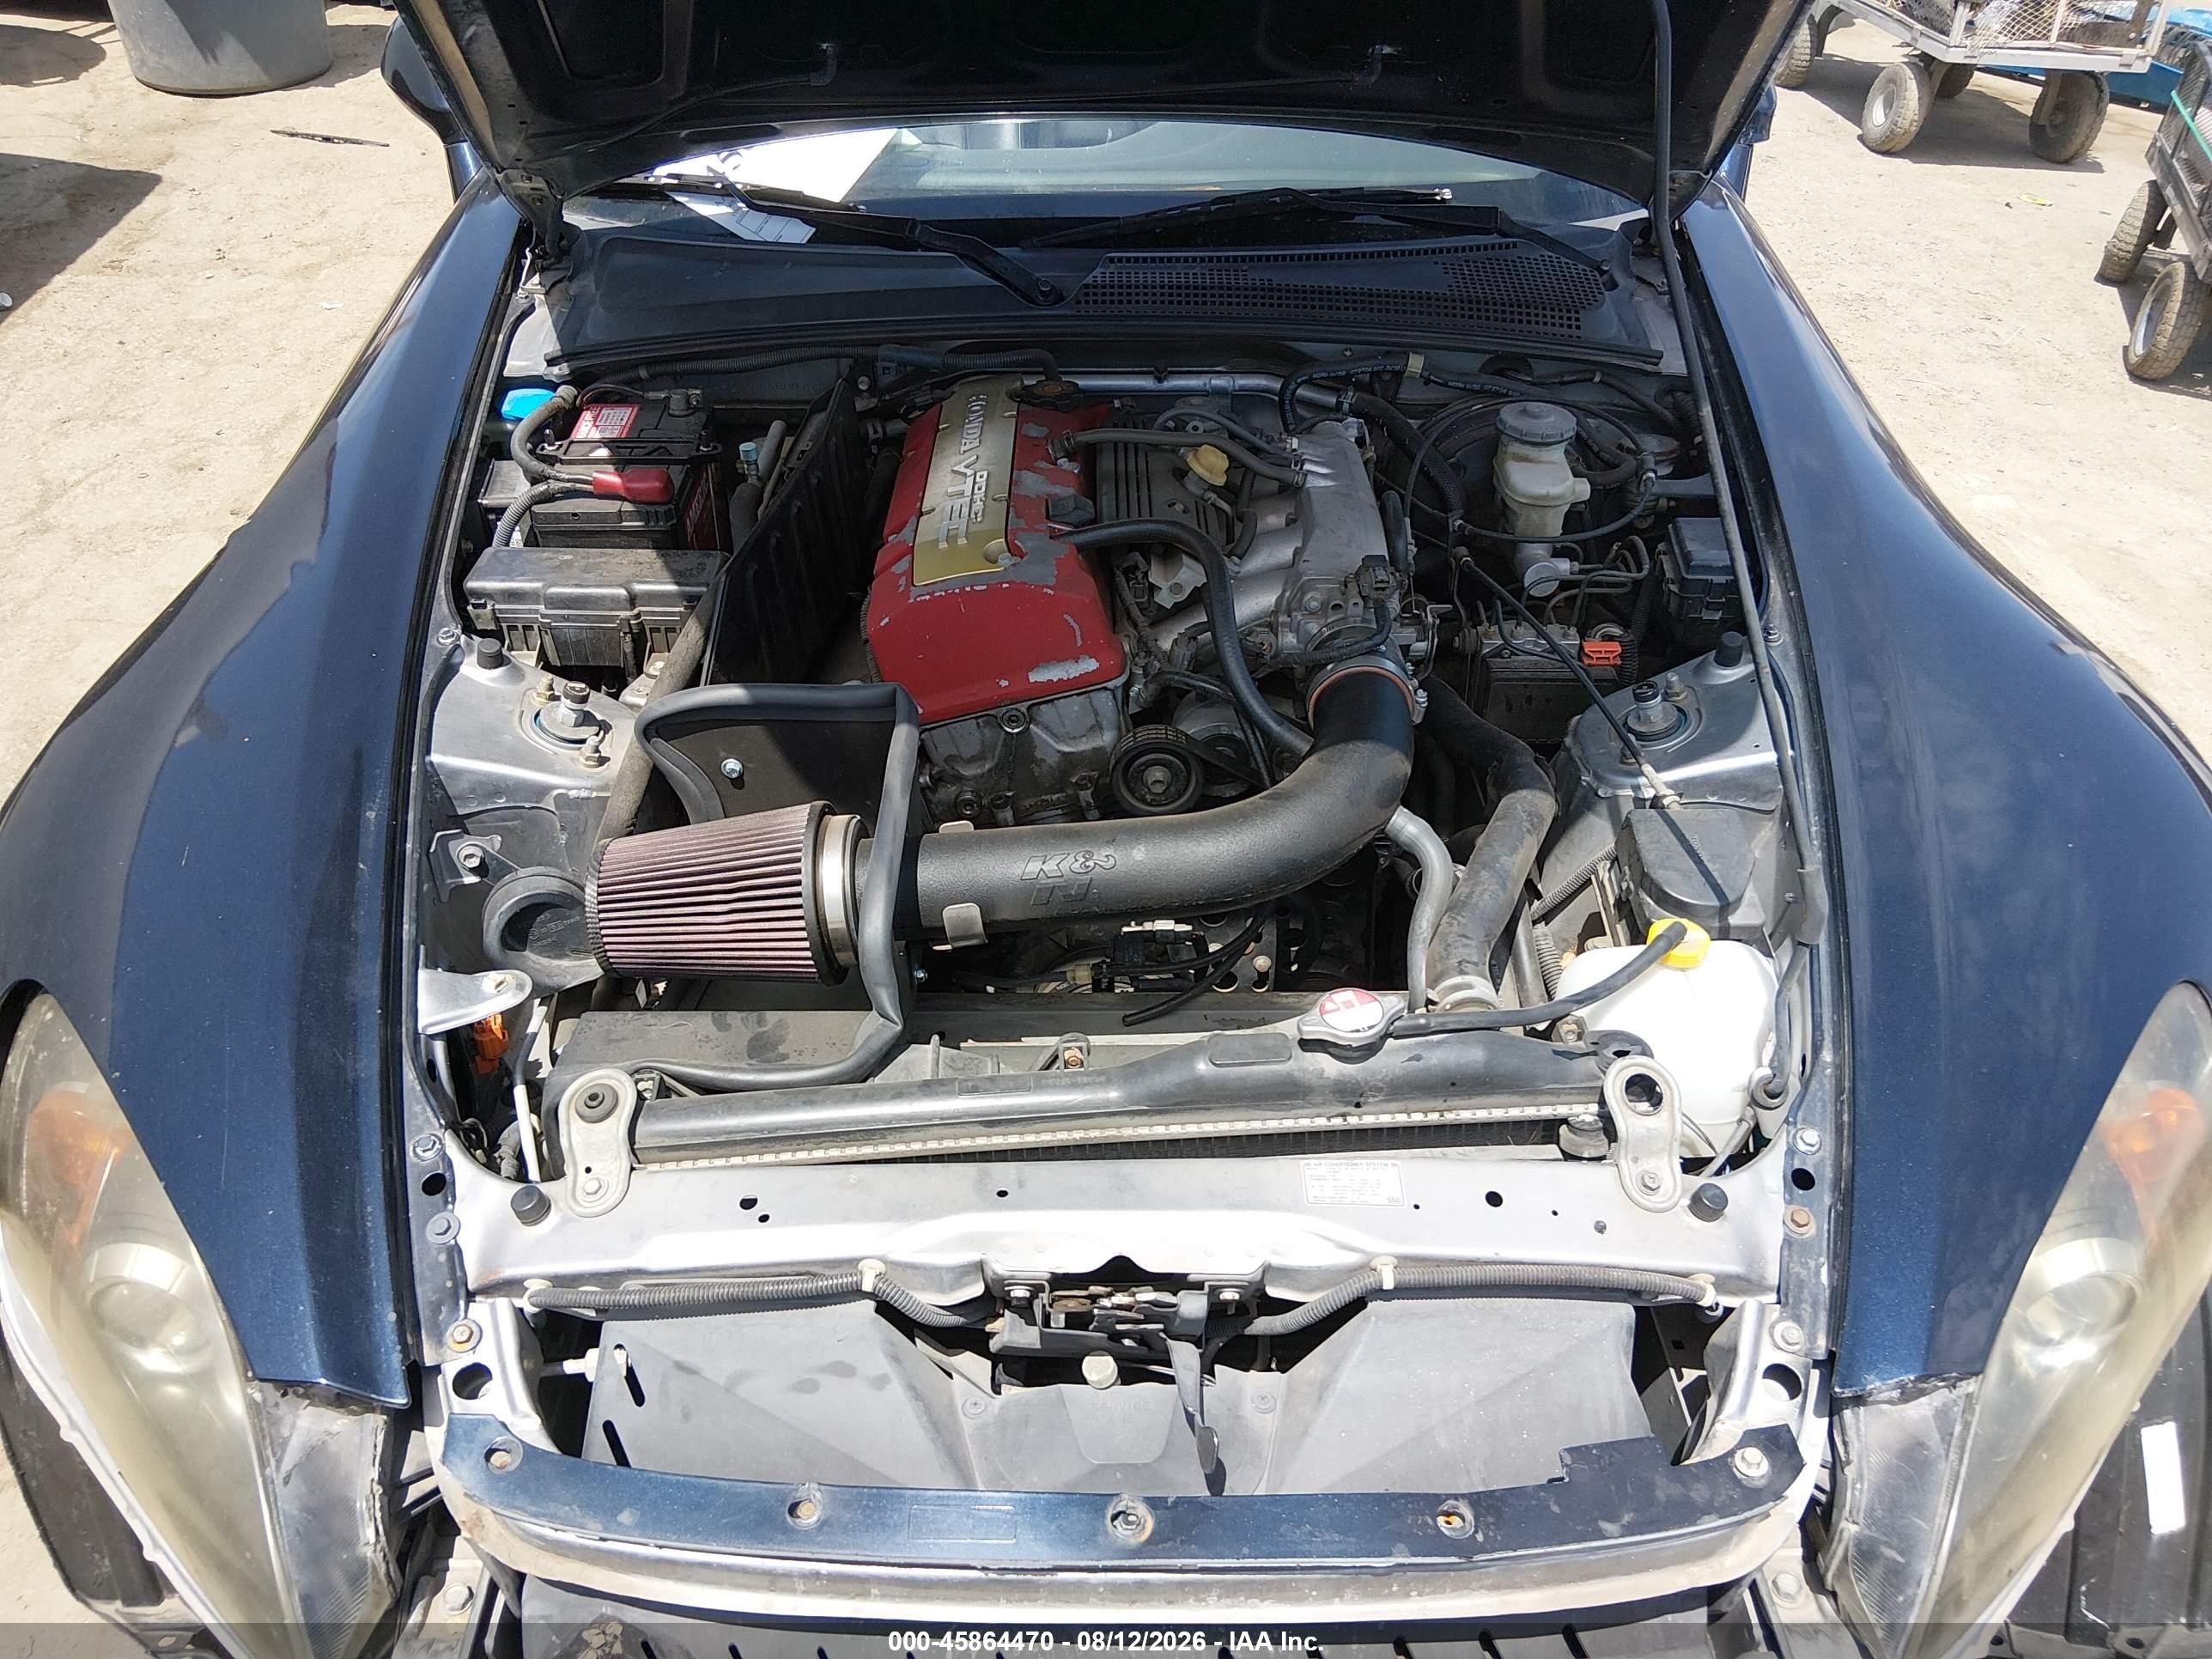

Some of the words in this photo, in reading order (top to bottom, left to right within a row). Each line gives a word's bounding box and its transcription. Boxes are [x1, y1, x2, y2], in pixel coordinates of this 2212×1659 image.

[960, 394, 988, 454] HONDA
[938, 453, 979, 550] VTEC
[969, 470, 988, 523] DOHC
